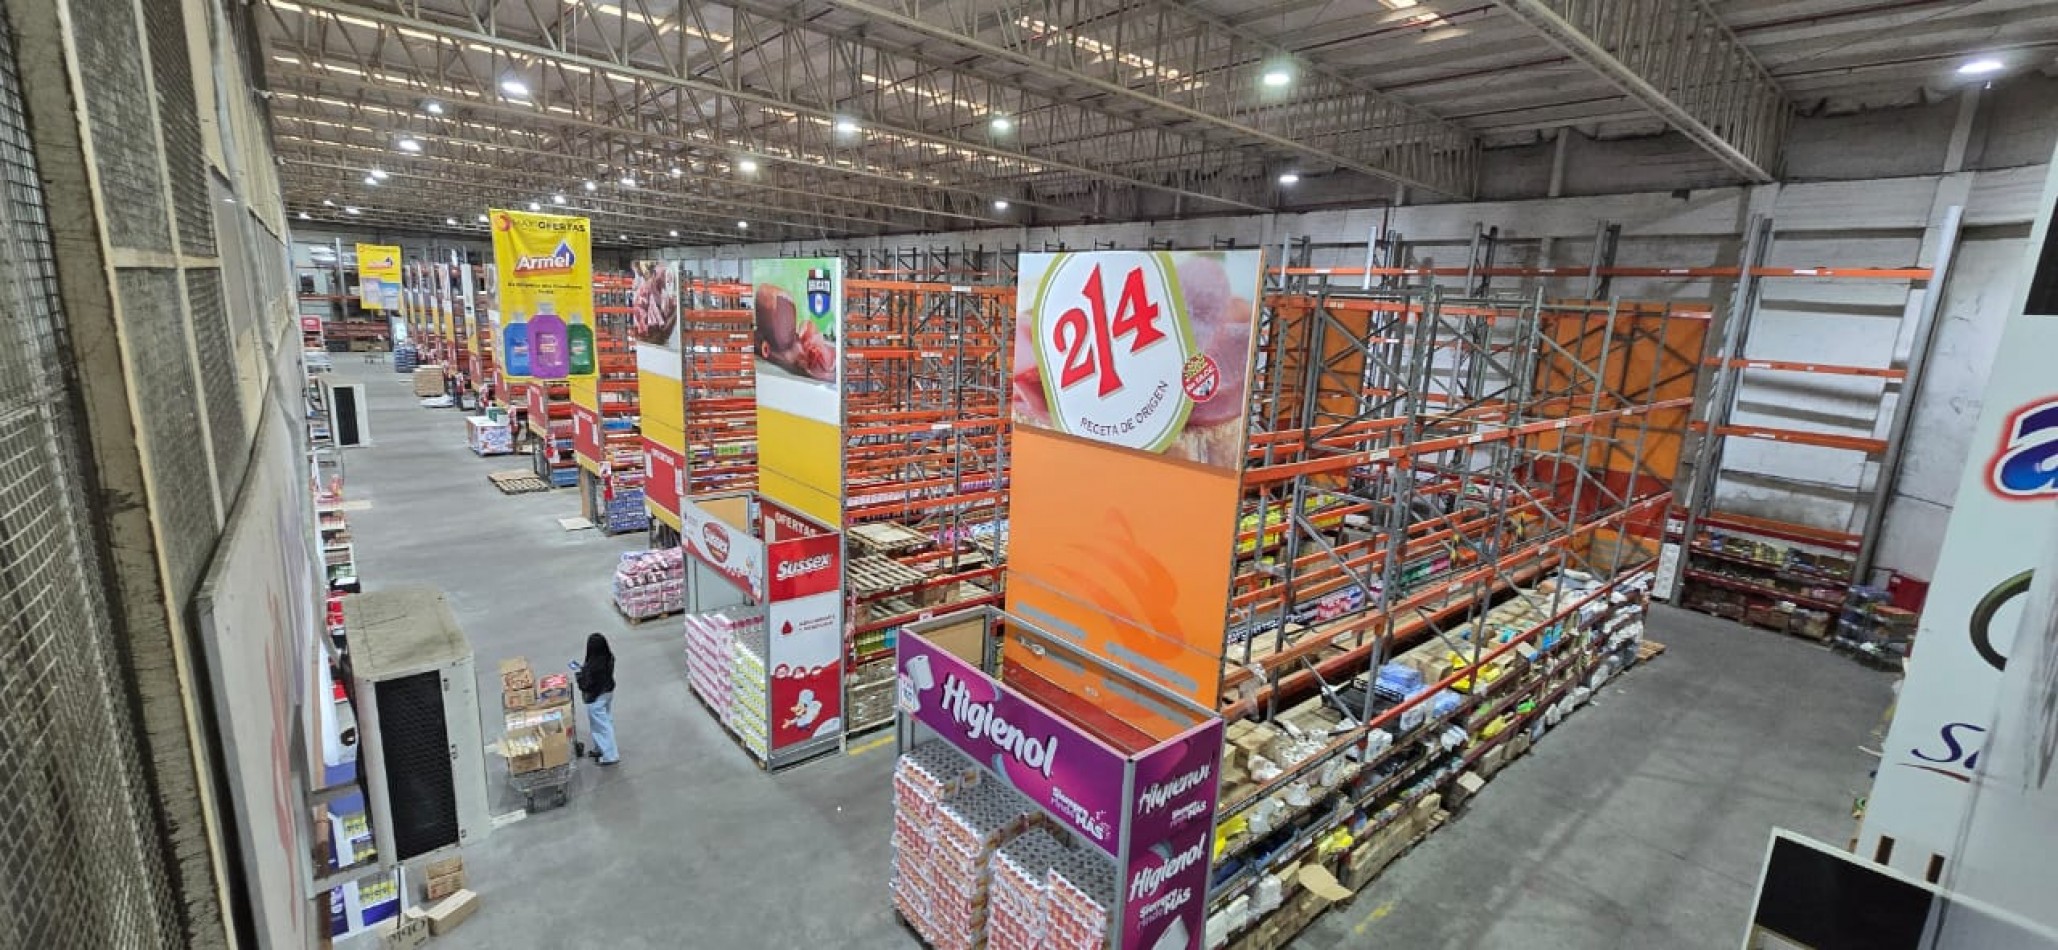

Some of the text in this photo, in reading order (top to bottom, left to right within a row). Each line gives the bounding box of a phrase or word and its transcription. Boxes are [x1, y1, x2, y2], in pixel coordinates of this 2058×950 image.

[516, 252, 570, 270] Armel
[1080, 416, 1119, 436] RECETA
[1120, 418, 1136, 434] DE
[1136, 381, 1169, 424] ORIGEN
[776, 554, 832, 580] Sussex
[940, 673, 1058, 778] Higienol
[1128, 831, 1206, 903] Higienol
